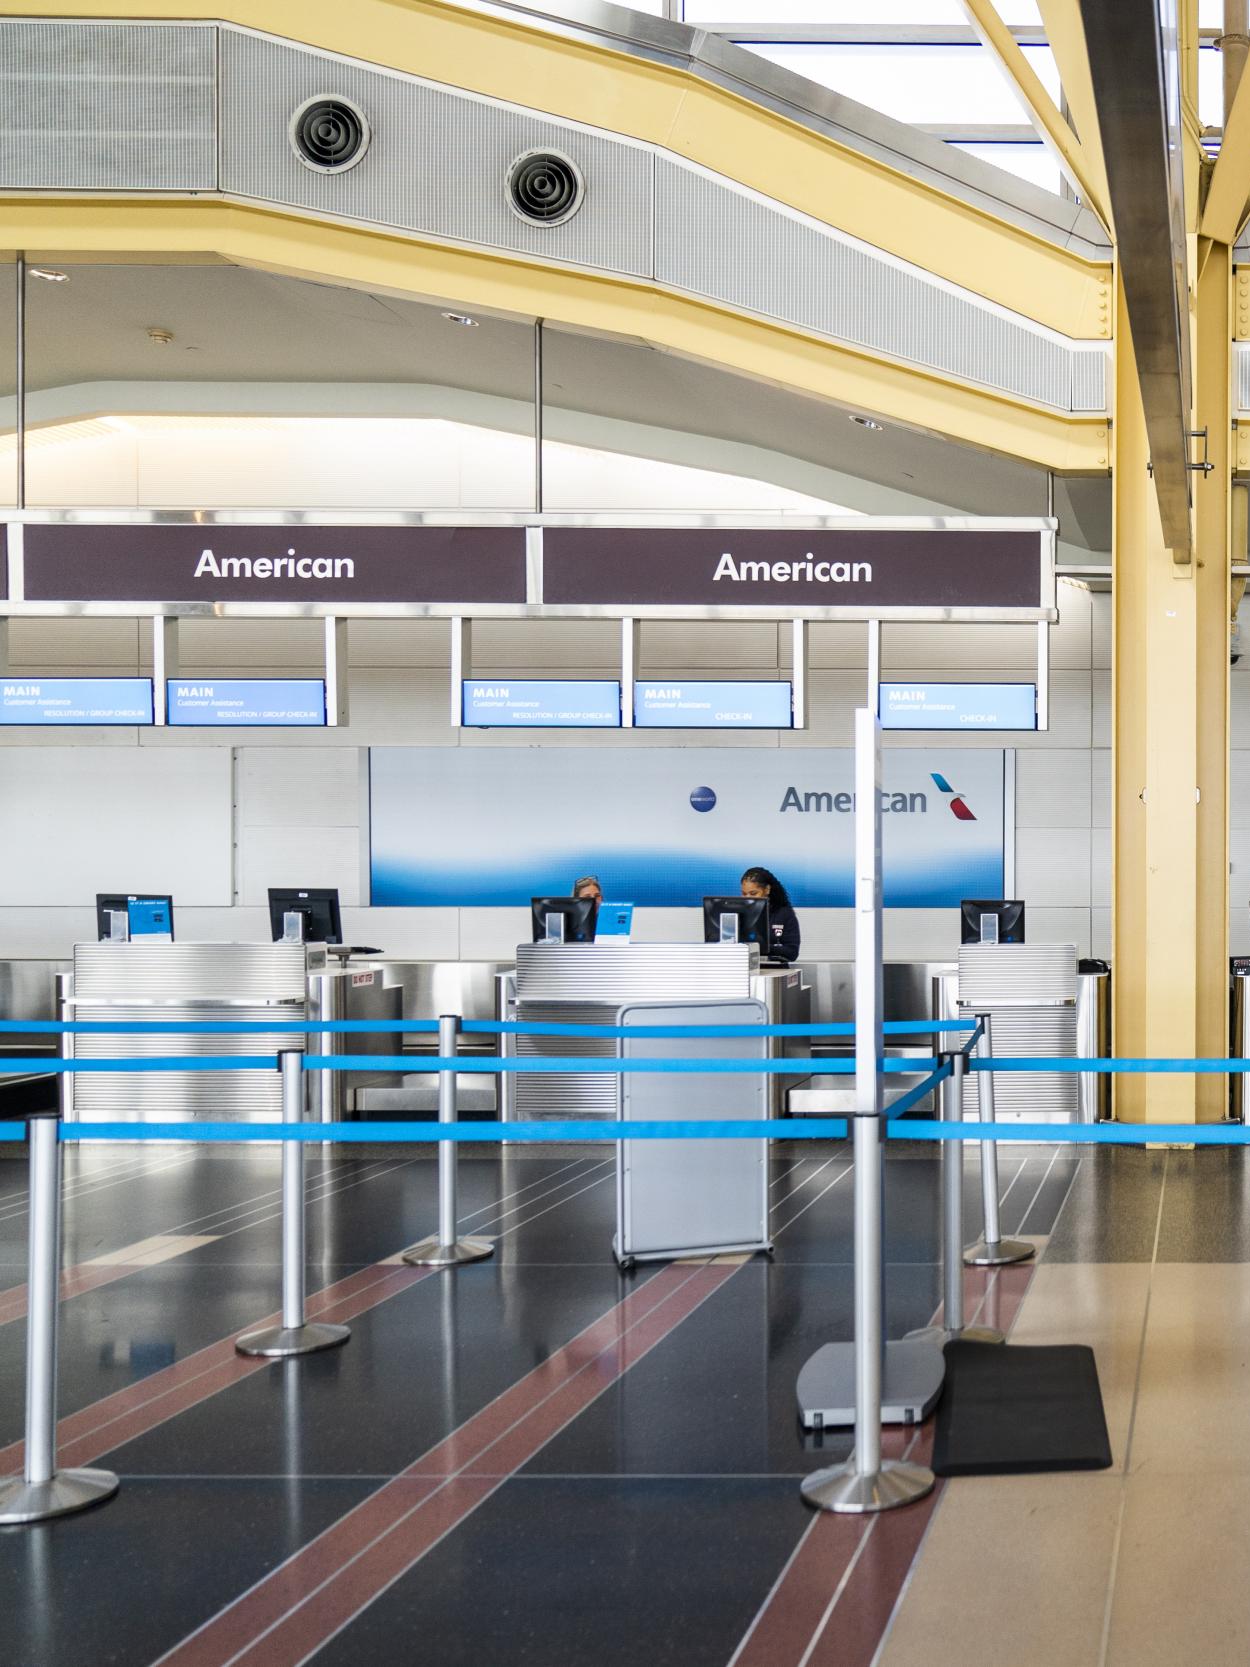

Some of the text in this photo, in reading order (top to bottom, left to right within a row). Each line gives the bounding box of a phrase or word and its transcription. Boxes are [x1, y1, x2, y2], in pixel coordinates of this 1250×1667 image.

[193, 548, 355, 579] American
[712, 552, 872, 583] American
[3, 686, 41, 697] MAIN
[177, 687, 214, 697] MAIN
[472, 688, 510, 698] MAIN
[644, 689, 682, 699] MAIN
[888, 690, 926, 701] MAIN
[177, 699, 244, 707] Customer Assistance
